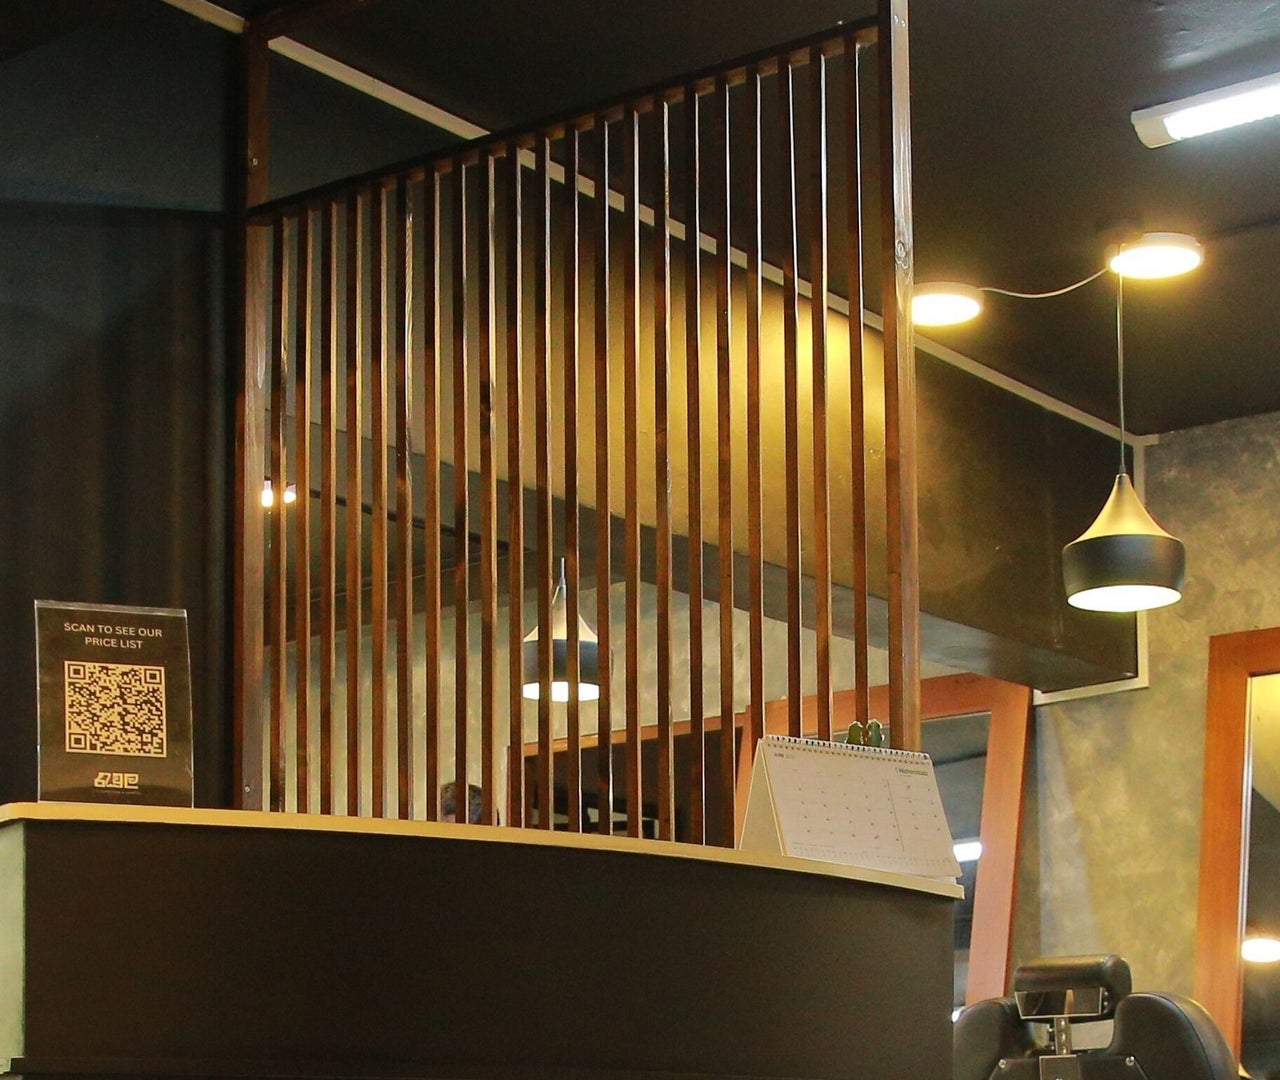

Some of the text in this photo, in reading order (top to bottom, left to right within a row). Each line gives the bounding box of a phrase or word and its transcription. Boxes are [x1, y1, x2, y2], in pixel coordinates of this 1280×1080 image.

[64, 622, 163, 638] SCAN TO SEE OUR
[85, 636, 143, 649] PRICE LIST
